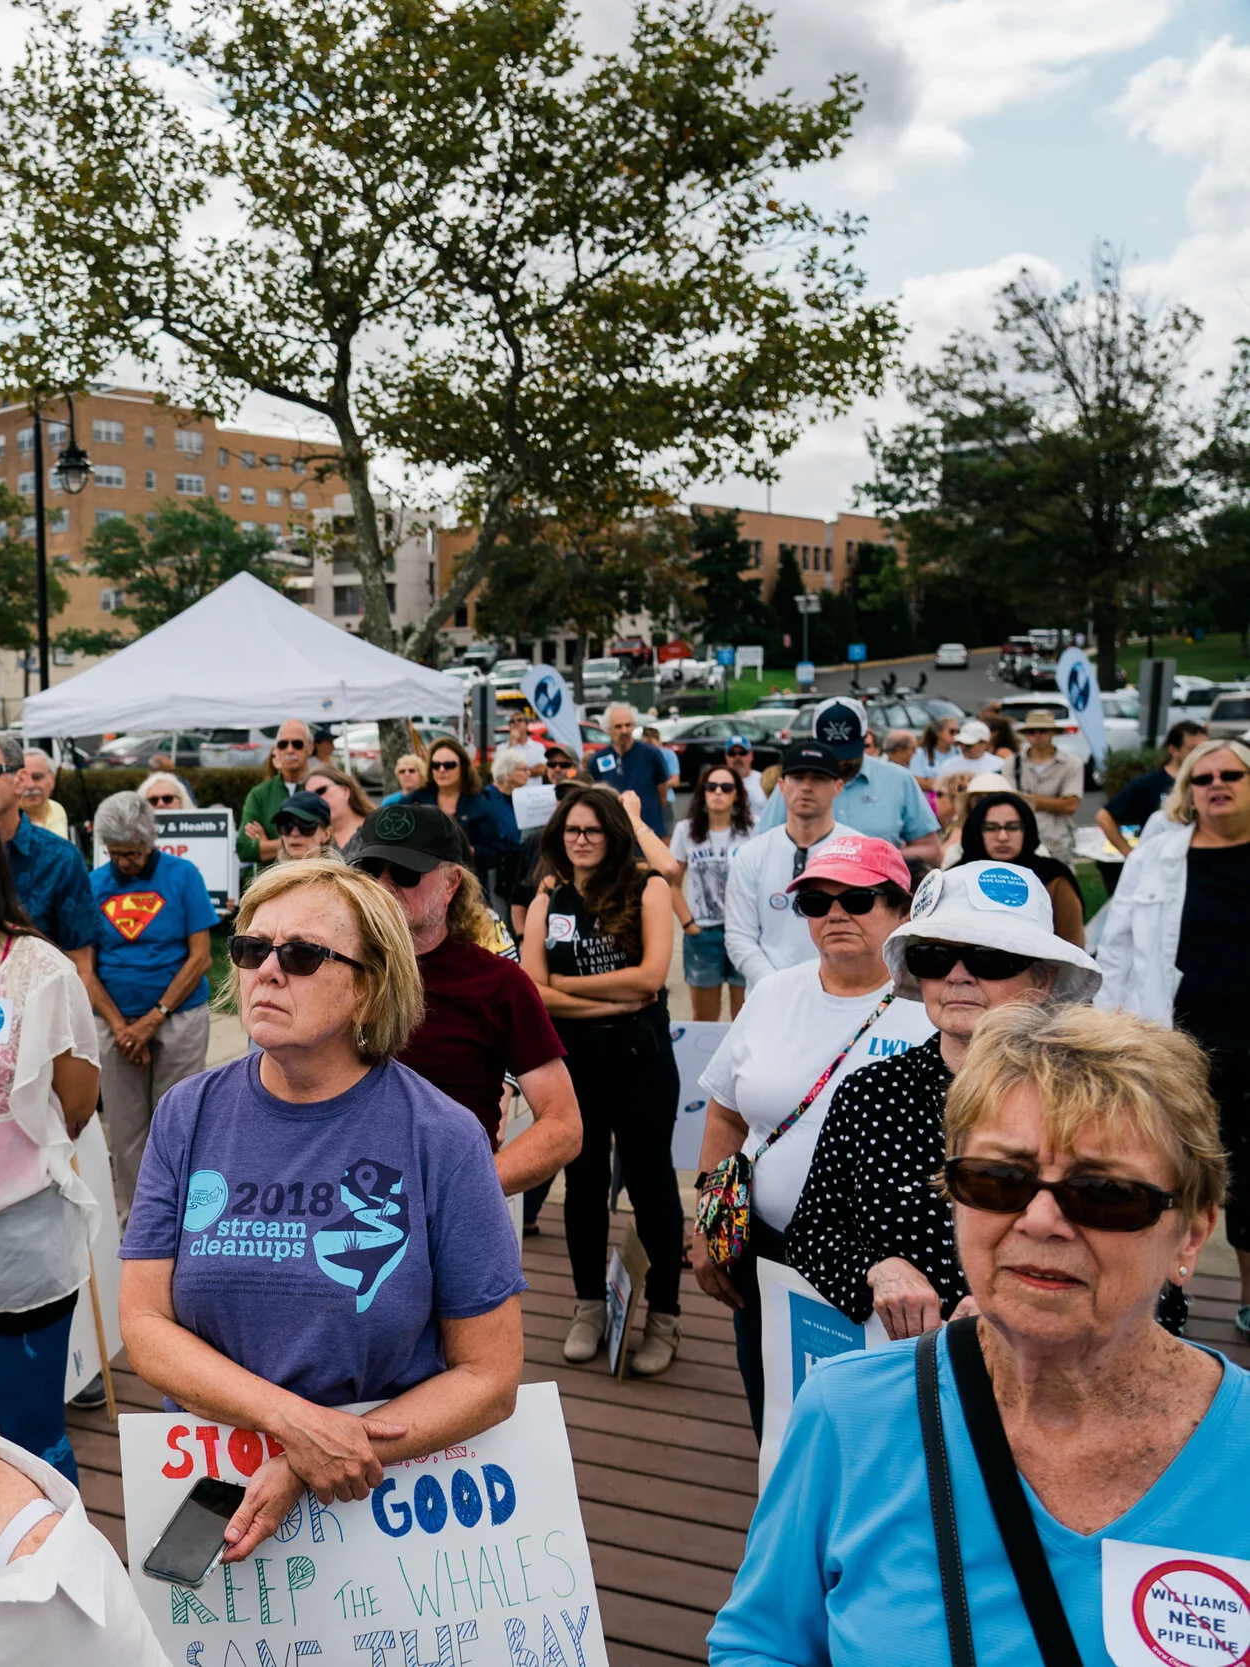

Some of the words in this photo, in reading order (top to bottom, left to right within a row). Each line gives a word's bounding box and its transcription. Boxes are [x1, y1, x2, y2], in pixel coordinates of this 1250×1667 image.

[179, 821, 217, 832] Health
[231, 1181, 335, 1217] 2018
[216, 1218, 308, 1239] stream
[189, 1234, 306, 1263] cleanups
[371, 1463, 517, 1539] GOOD
[171, 1555, 316, 1626] KEEP
[333, 1580, 383, 1620] THE
[397, 1529, 577, 1618] WHALES
[1151, 1587, 1243, 1615] WILLIAMS/
[1168, 1610, 1226, 1633] NESE
[504, 1605, 590, 1667] BAY
[1157, 1628, 1239, 1654] PIPELINE
